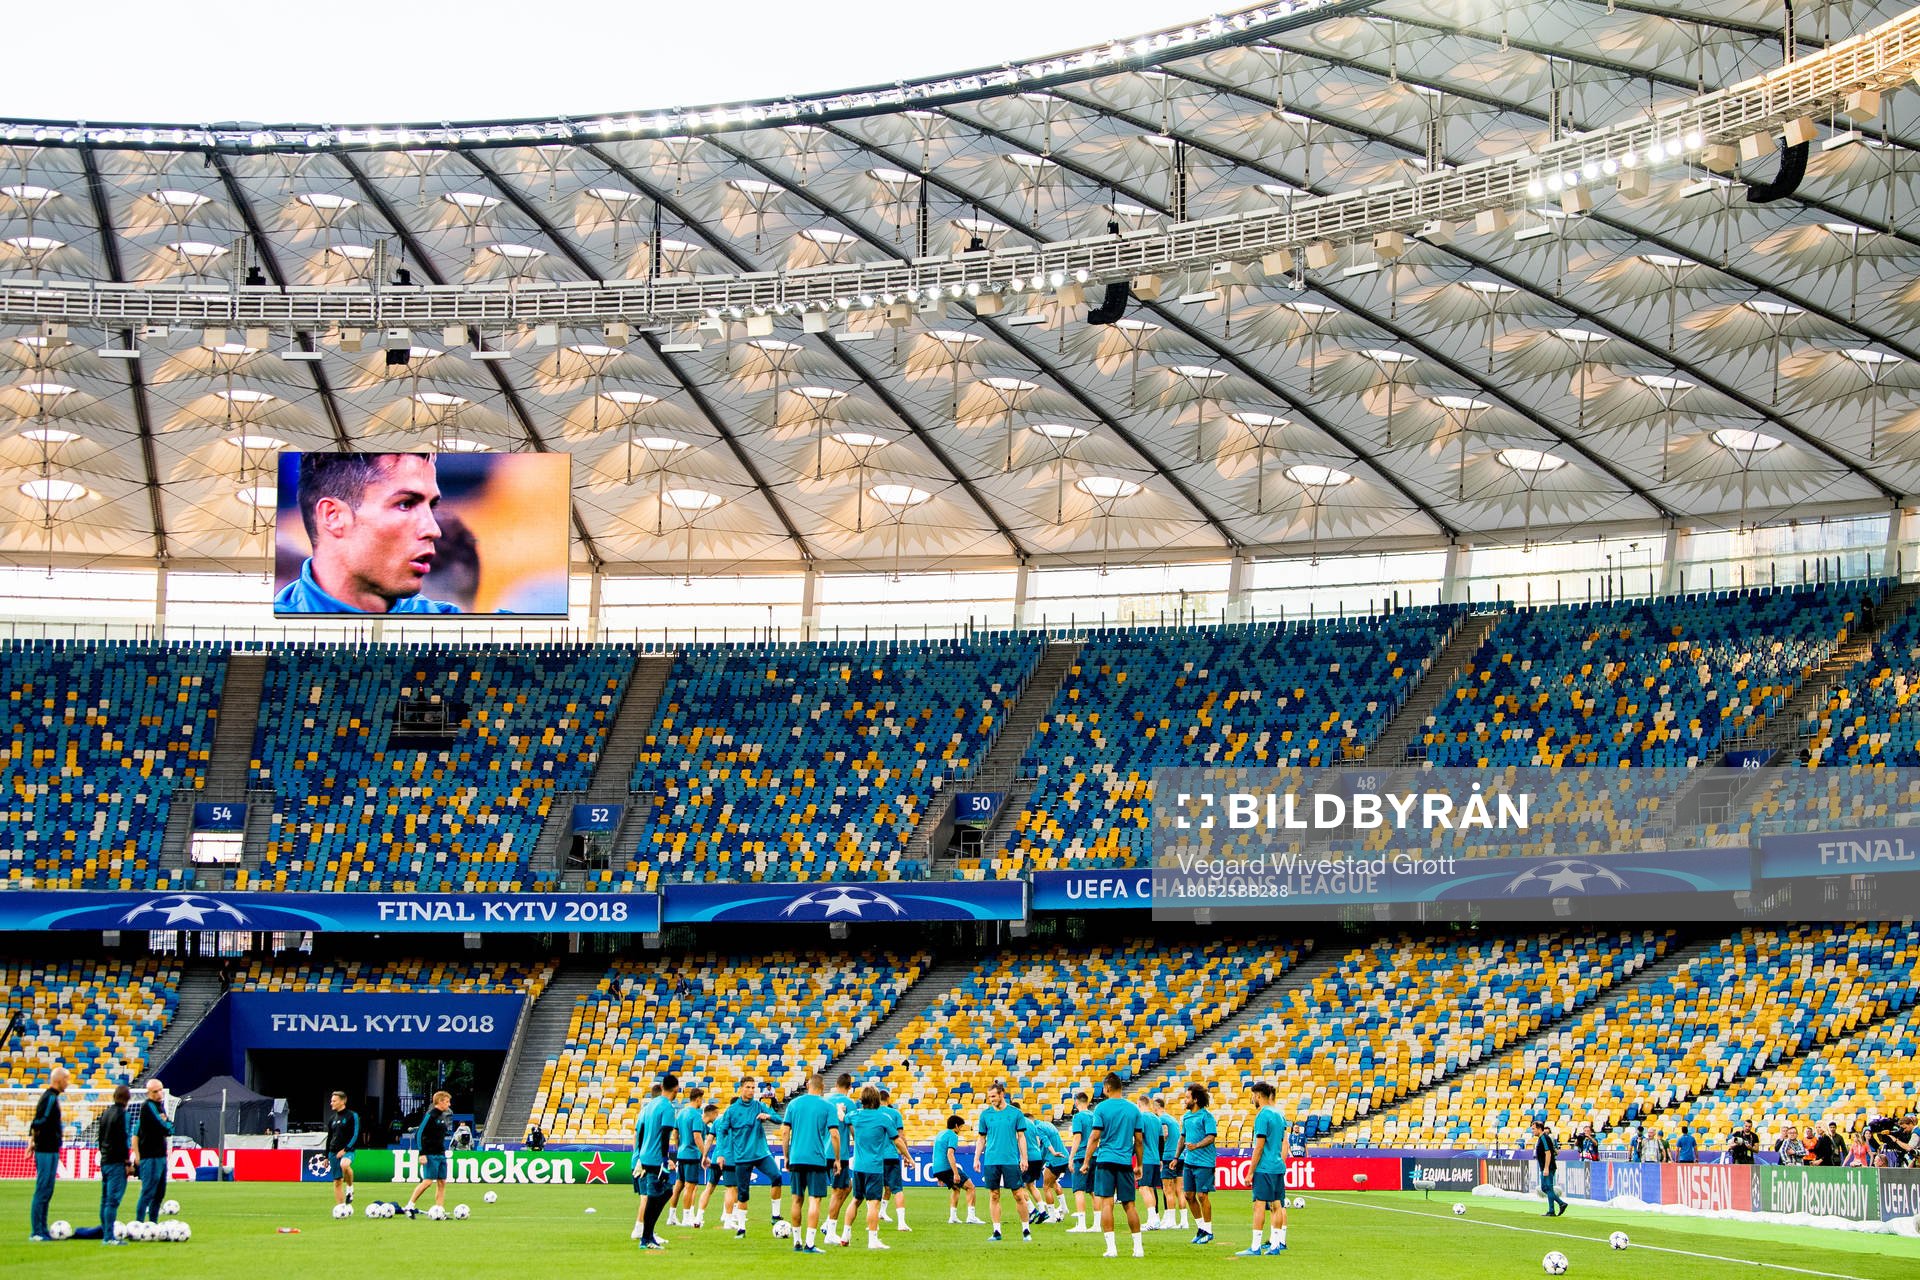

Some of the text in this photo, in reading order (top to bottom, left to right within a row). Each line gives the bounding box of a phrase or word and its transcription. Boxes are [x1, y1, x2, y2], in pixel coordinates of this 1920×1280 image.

[1356, 776, 1376, 791] 48
[212, 806, 232, 821] 54
[590, 808, 609, 823] 52
[971, 797, 991, 811] 50
[1818, 838, 1915, 865] FINAL
[1066, 878, 1128, 899] UEFA
[1288, 873, 1378, 896] LEAGUE
[377, 901, 628, 921] FINAL KYIV 2018
[271, 1014, 495, 1033] FINAL KYIV 2018
[391, 1149, 576, 1184] Hineken
[1677, 1165, 1732, 1211] NISSAN
[1771, 1170, 1799, 1214] Enjoy
[1801, 1170, 1869, 1221] Responsibly
[1883, 1183, 1910, 1215] UEFA
